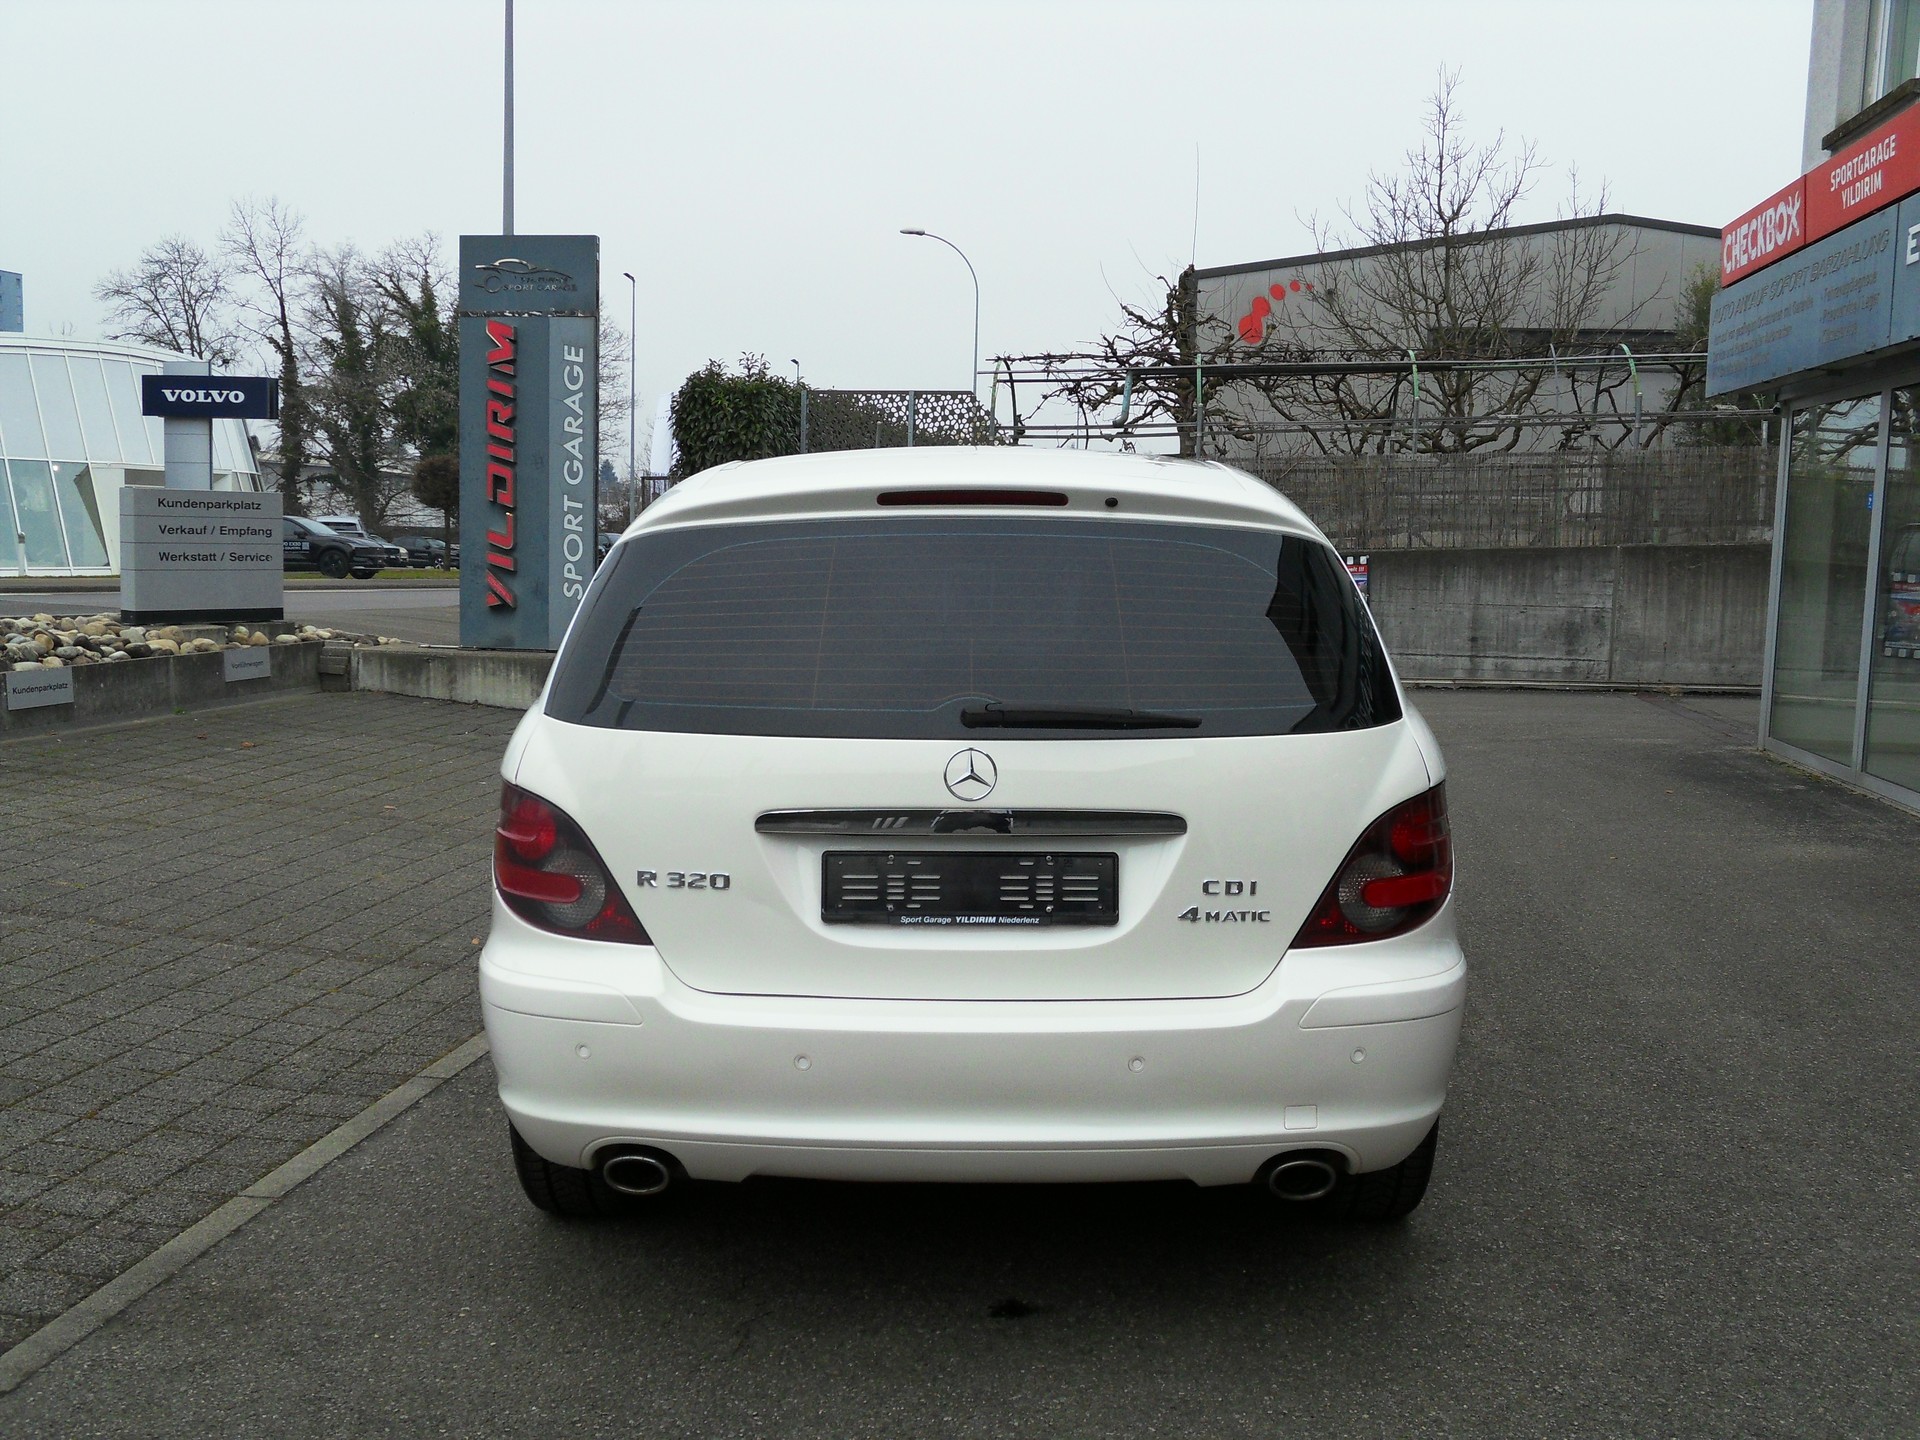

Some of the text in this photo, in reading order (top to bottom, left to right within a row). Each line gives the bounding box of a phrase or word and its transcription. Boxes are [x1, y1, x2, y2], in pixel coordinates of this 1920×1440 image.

[1830, 134, 1896, 192] SPORTGARAGE
[1841, 169, 1882, 209] YILDIRIM
[1723, 191, 1801, 274] CHECKBOX
[1770, 265, 1810, 301] SOFORT
[1810, 229, 1890, 282] BARZAHLUNG
[161, 389, 245, 403] VOLVO
[486, 319, 517, 609] YILDIRIM
[563, 345, 584, 601] SPORT GARAGE
[157, 498, 261, 511] Kundenparkplatz
[159, 524, 207, 535] Verkauf
[220, 525, 273, 538] Empfang
[159, 552, 217, 562] Werkstatt
[229, 552, 273, 562] Service
[12, 682, 69, 695] Kundenparkplatz
[637, 869, 731, 890] R 320
[1202, 879, 1257, 896] CDI
[900, 915, 1040, 926] Sport Garage YILDIRIM Niederlenz
